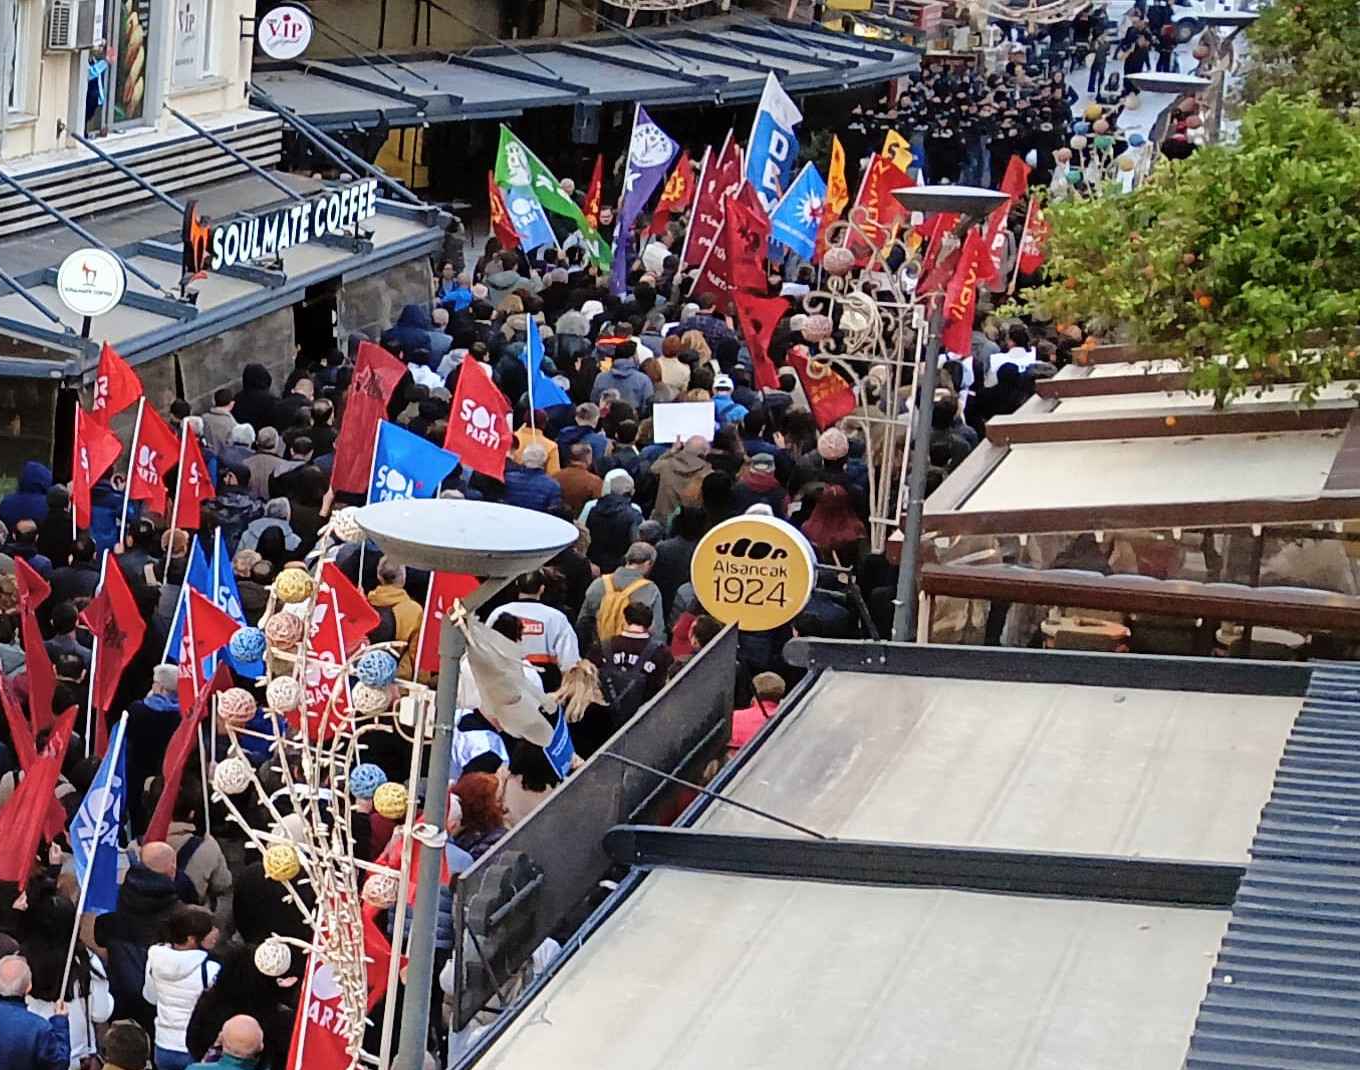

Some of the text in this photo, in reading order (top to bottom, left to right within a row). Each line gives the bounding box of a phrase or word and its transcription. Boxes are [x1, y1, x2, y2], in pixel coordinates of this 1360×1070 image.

[211, 179, 379, 271] SOULMATE COFFEE
[460, 398, 496, 434] SOL
[713, 560, 788, 579] Alsancak
[713, 576, 788, 608] 1924
